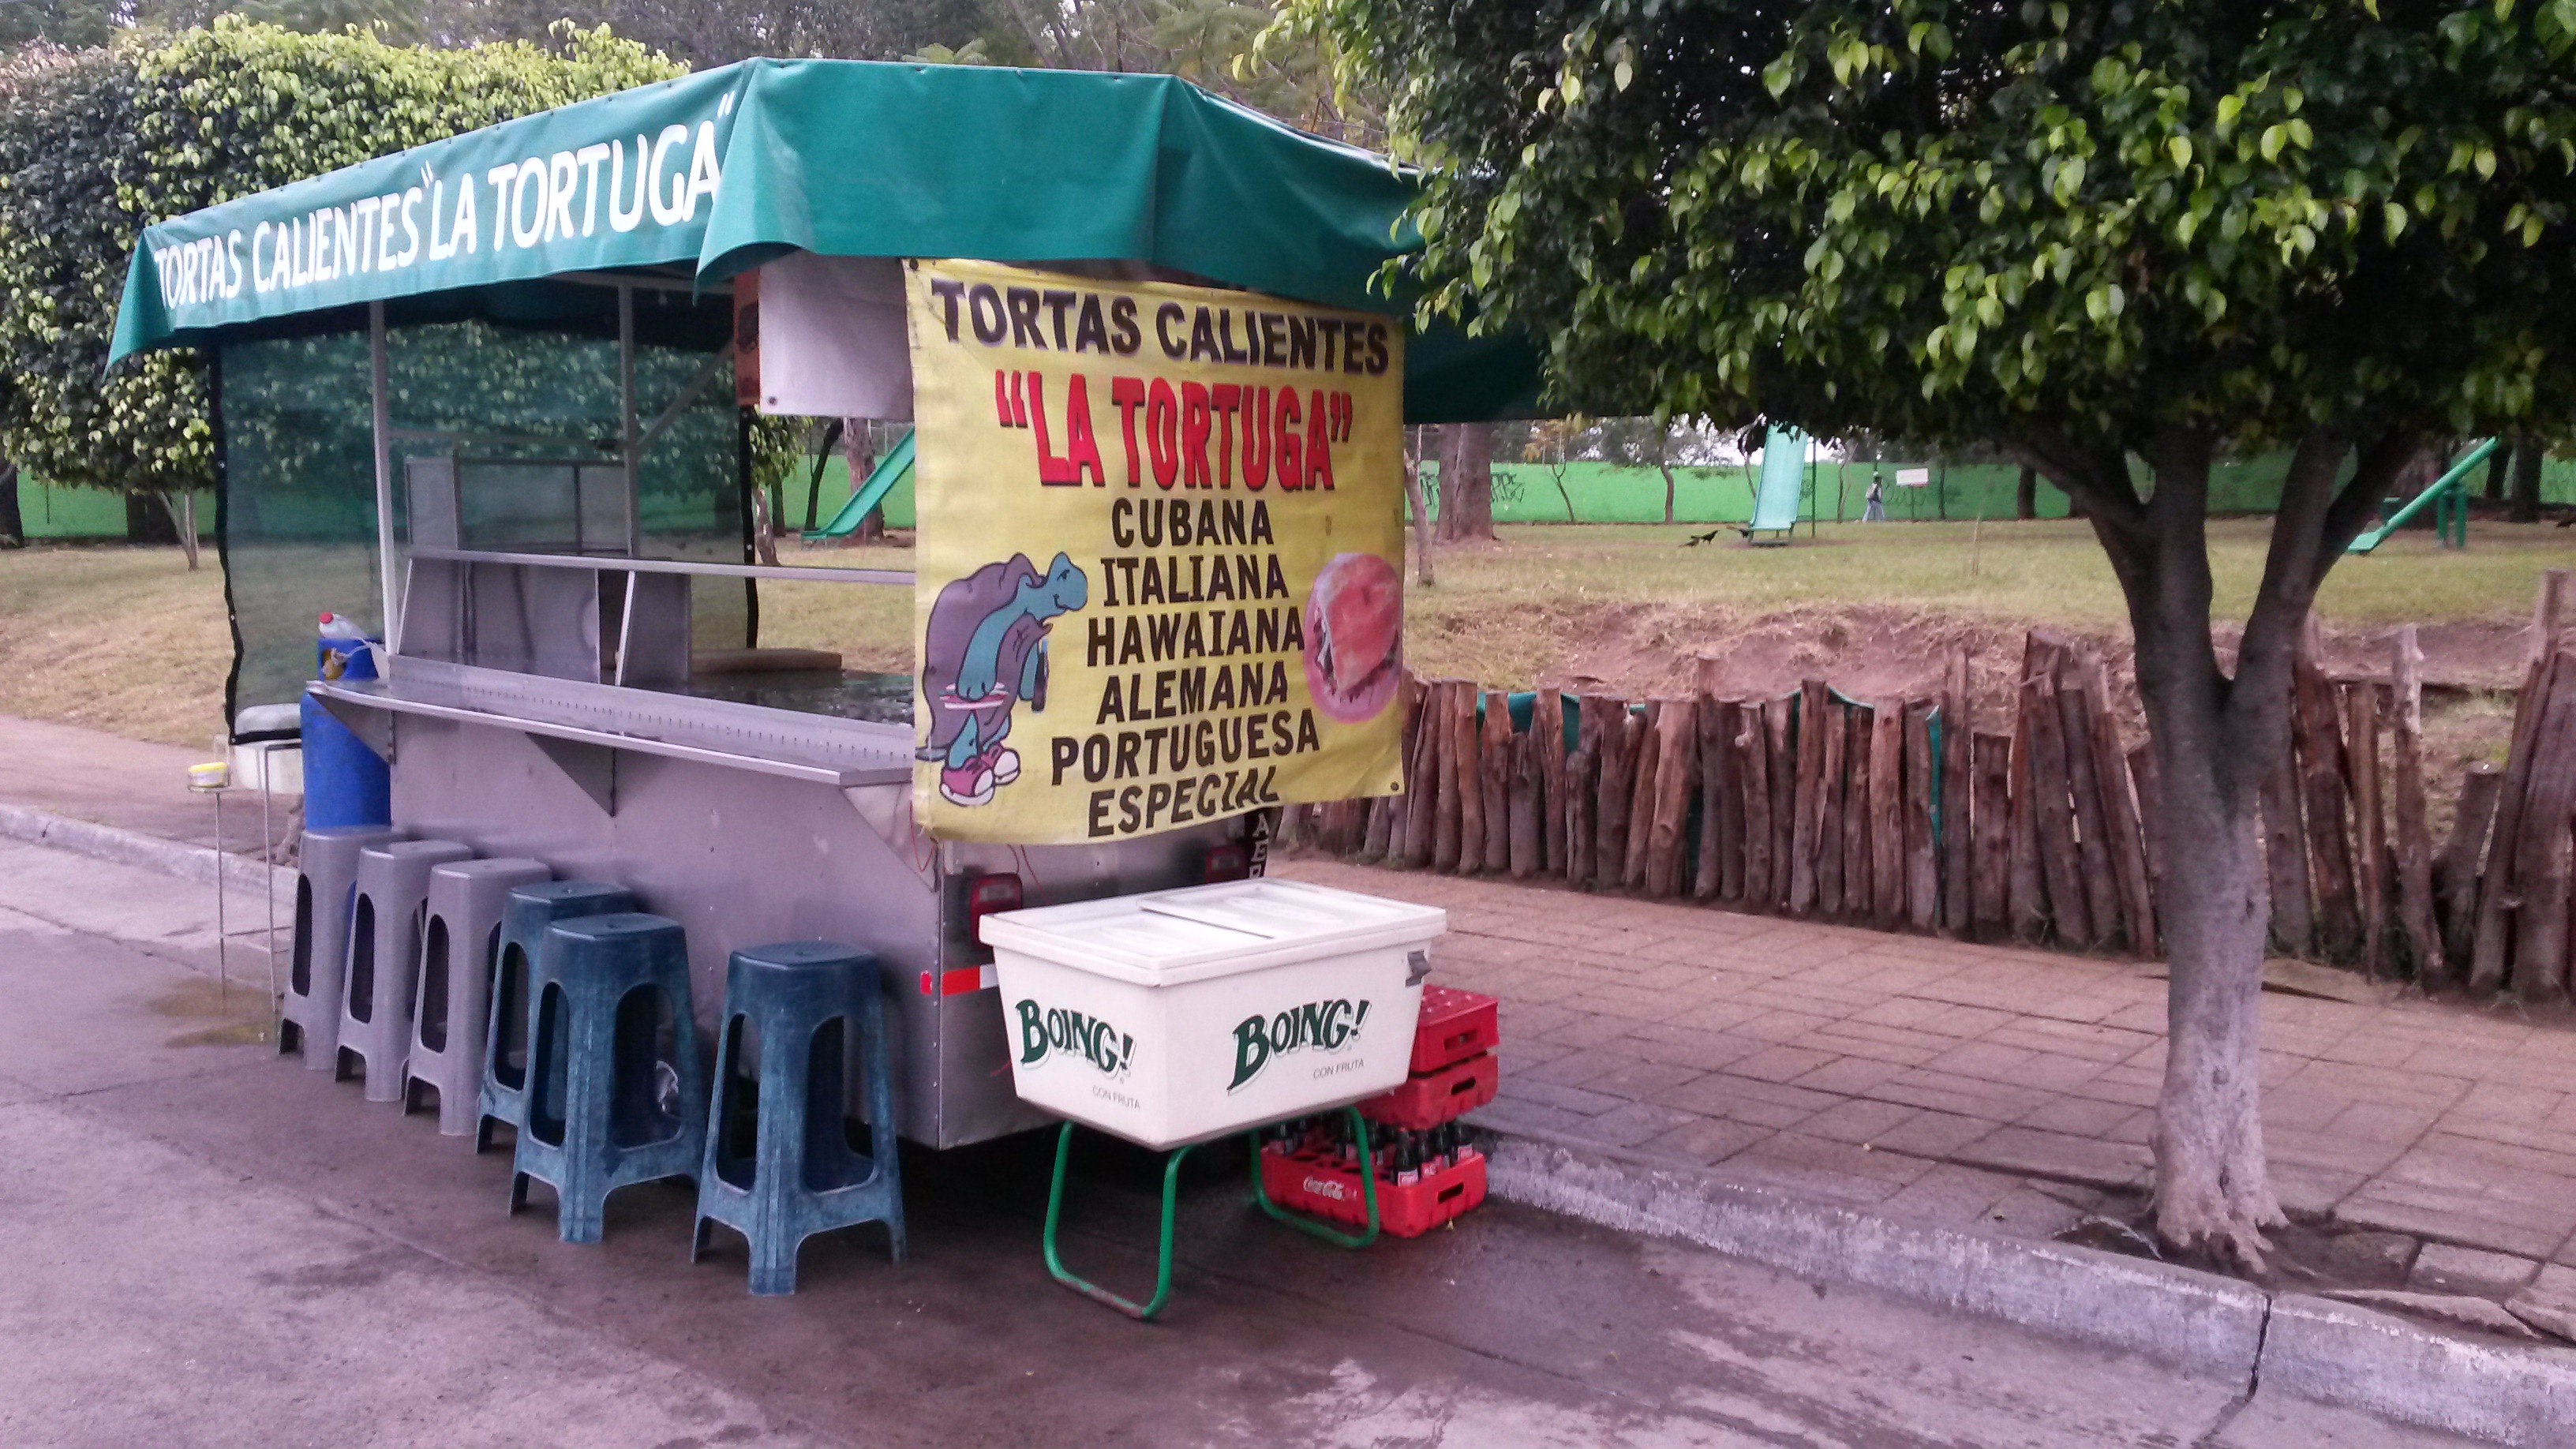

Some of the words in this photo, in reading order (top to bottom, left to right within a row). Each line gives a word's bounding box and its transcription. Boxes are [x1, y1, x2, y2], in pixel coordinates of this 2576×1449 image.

[154, 228, 243, 310] TORTAS
[252, 185, 423, 294] CALIENTES
[931, 278, 1142, 357] TORTAS
[1155, 301, 1390, 376] CALIENTES
[994, 369, 1106, 487] "LA
[1111, 375, 1353, 491] TORTUGA"
[1111, 498, 1275, 548] CUBANA
[1103, 553, 1290, 607] ITALIANA
[1086, 606, 1305, 667] HAWAIANA
[1095, 661, 1289, 724] ALEMANA
[1051, 708, 1320, 786] PORTUGUESA
[1087, 765, 1281, 837] ESPECIAL
[1015, 998, 1135, 1075] BOING!
[1226, 998, 1371, 1092] BOING!
[1312, 1065, 1334, 1080] CON
[1335, 1058, 1365, 1074] FRUTA
[1092, 1084, 1111, 1101] CON
[1113, 1092, 1141, 1110] FRUTA
